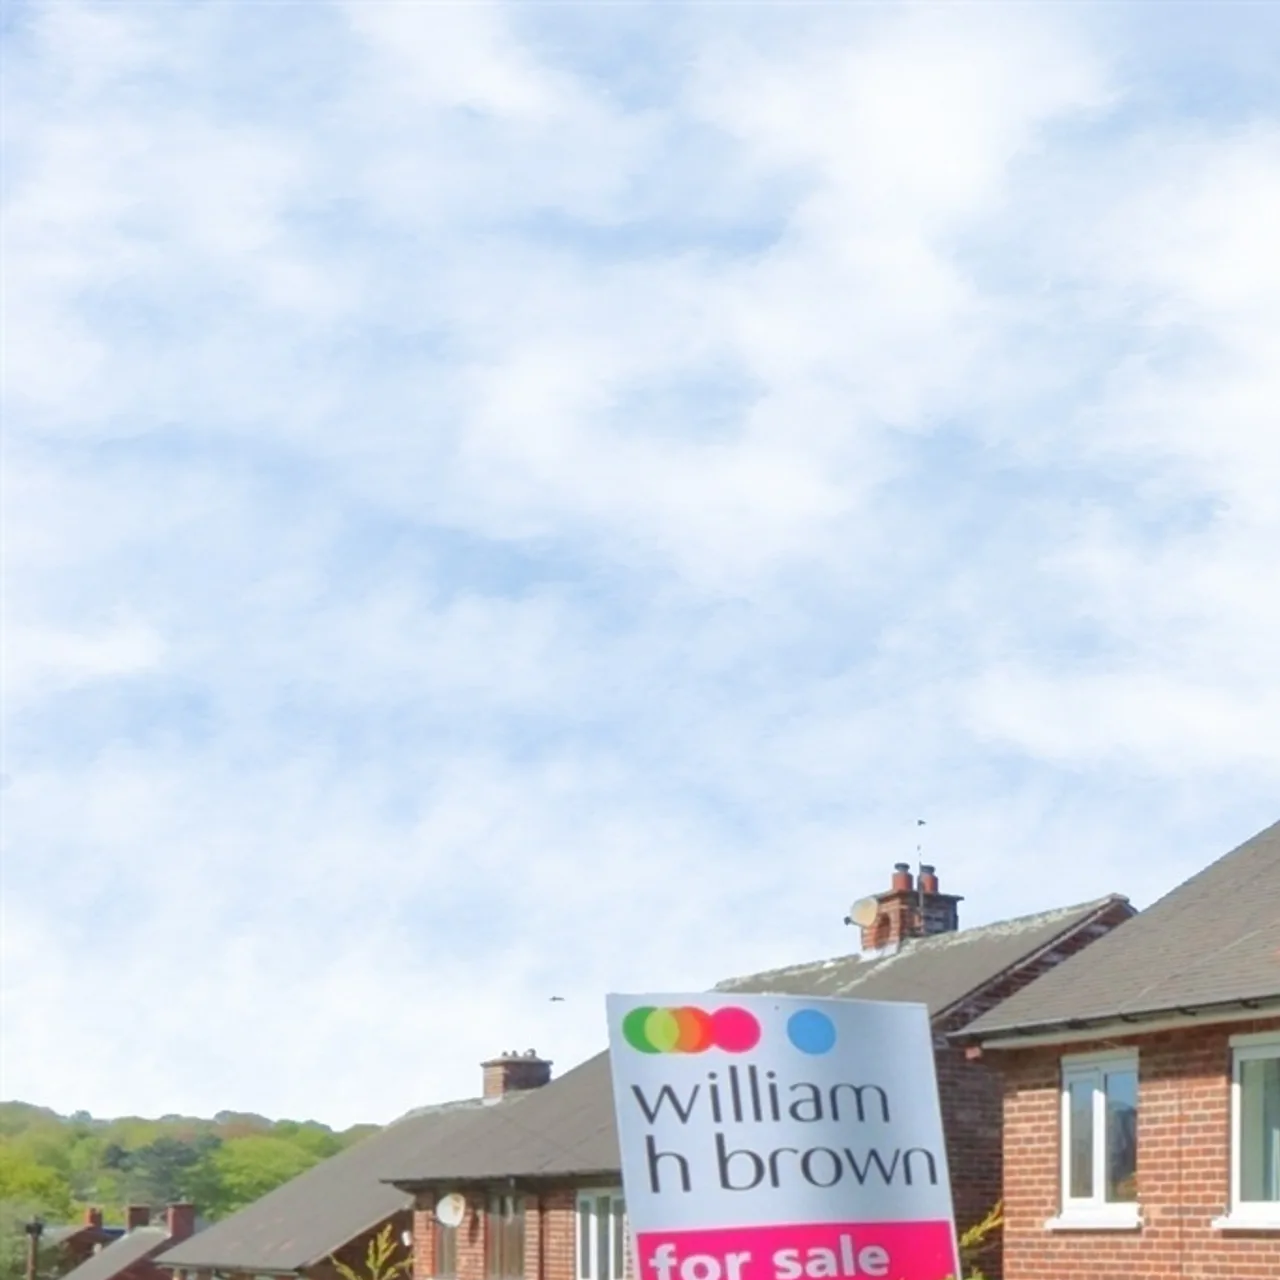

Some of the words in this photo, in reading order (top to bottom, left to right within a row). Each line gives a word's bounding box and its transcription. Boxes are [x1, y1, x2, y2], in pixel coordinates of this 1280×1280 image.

[631, 1064, 890, 1125] william
[645, 1133, 692, 1193] h
[715, 1132, 938, 1189] brown
